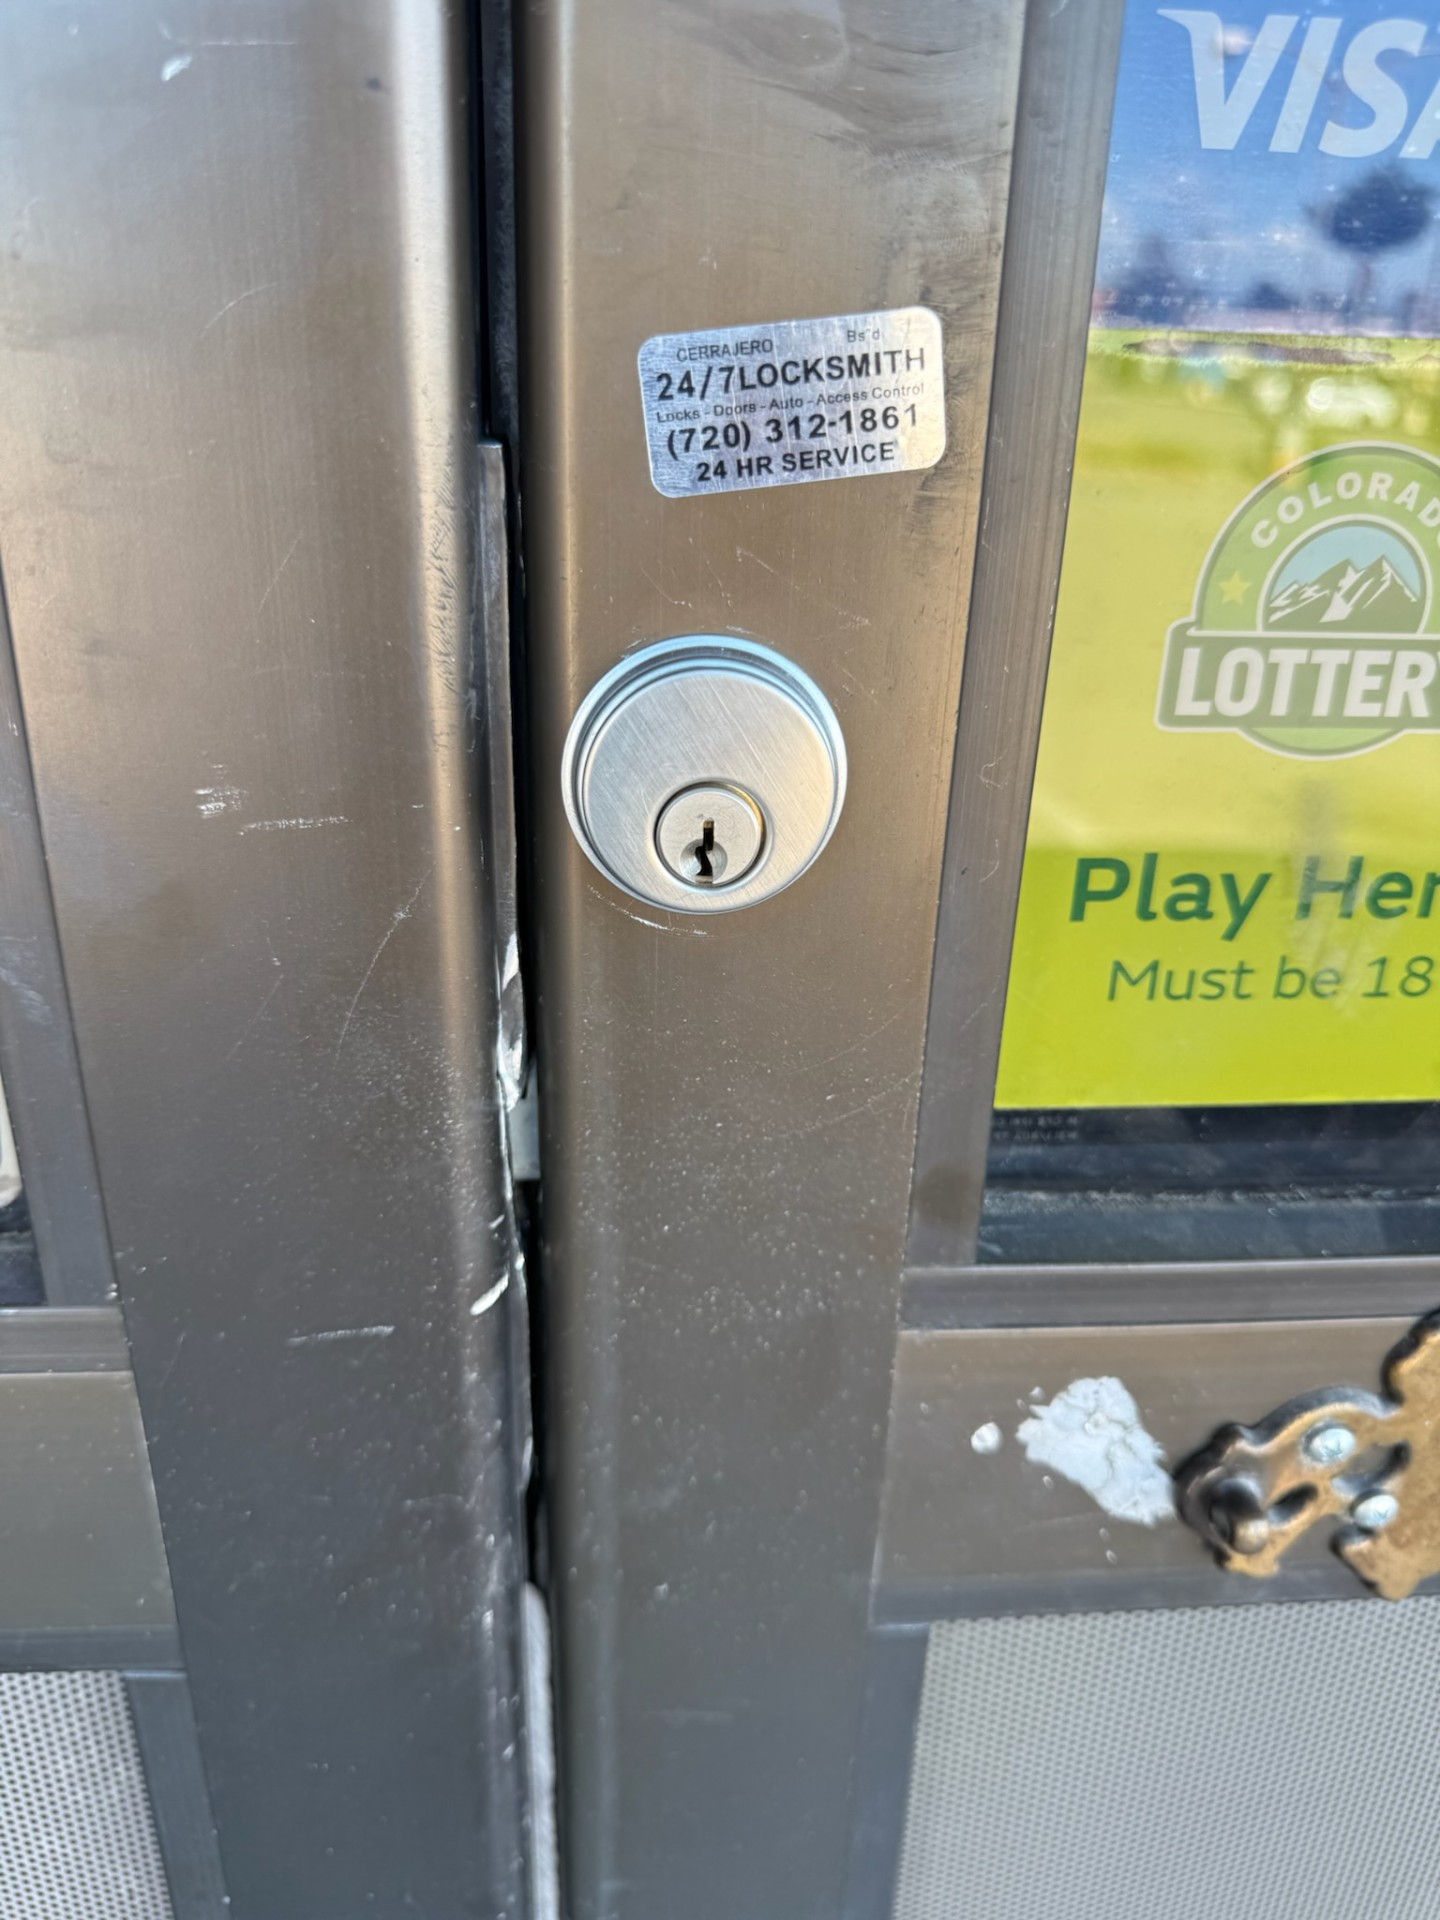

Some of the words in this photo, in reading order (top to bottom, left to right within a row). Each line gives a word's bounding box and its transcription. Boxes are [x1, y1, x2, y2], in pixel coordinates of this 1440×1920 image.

[676, 338, 774, 363] CERRAJERO
[656, 409, 701, 424] Locks
[713, 402, 757, 417] Doors
[769, 396, 804, 411] Auto
[816, 389, 868, 406] Access
[871, 382, 925, 400] Control
[667, 420, 752, 461] (720)
[765, 402, 917, 444] 312-1861
[696, 460, 728, 482] 24
[736, 455, 774, 479] HR
[781, 440, 896, 473] SERVICE
[1251, 471, 1440, 549] COLORAD
[1173, 647, 1440, 719] LOTTER
[1068, 852, 1273, 942] Play
[1106, 957, 1256, 1002] Must
[1272, 954, 1342, 1000] be
[1361, 954, 1435, 999] 18
